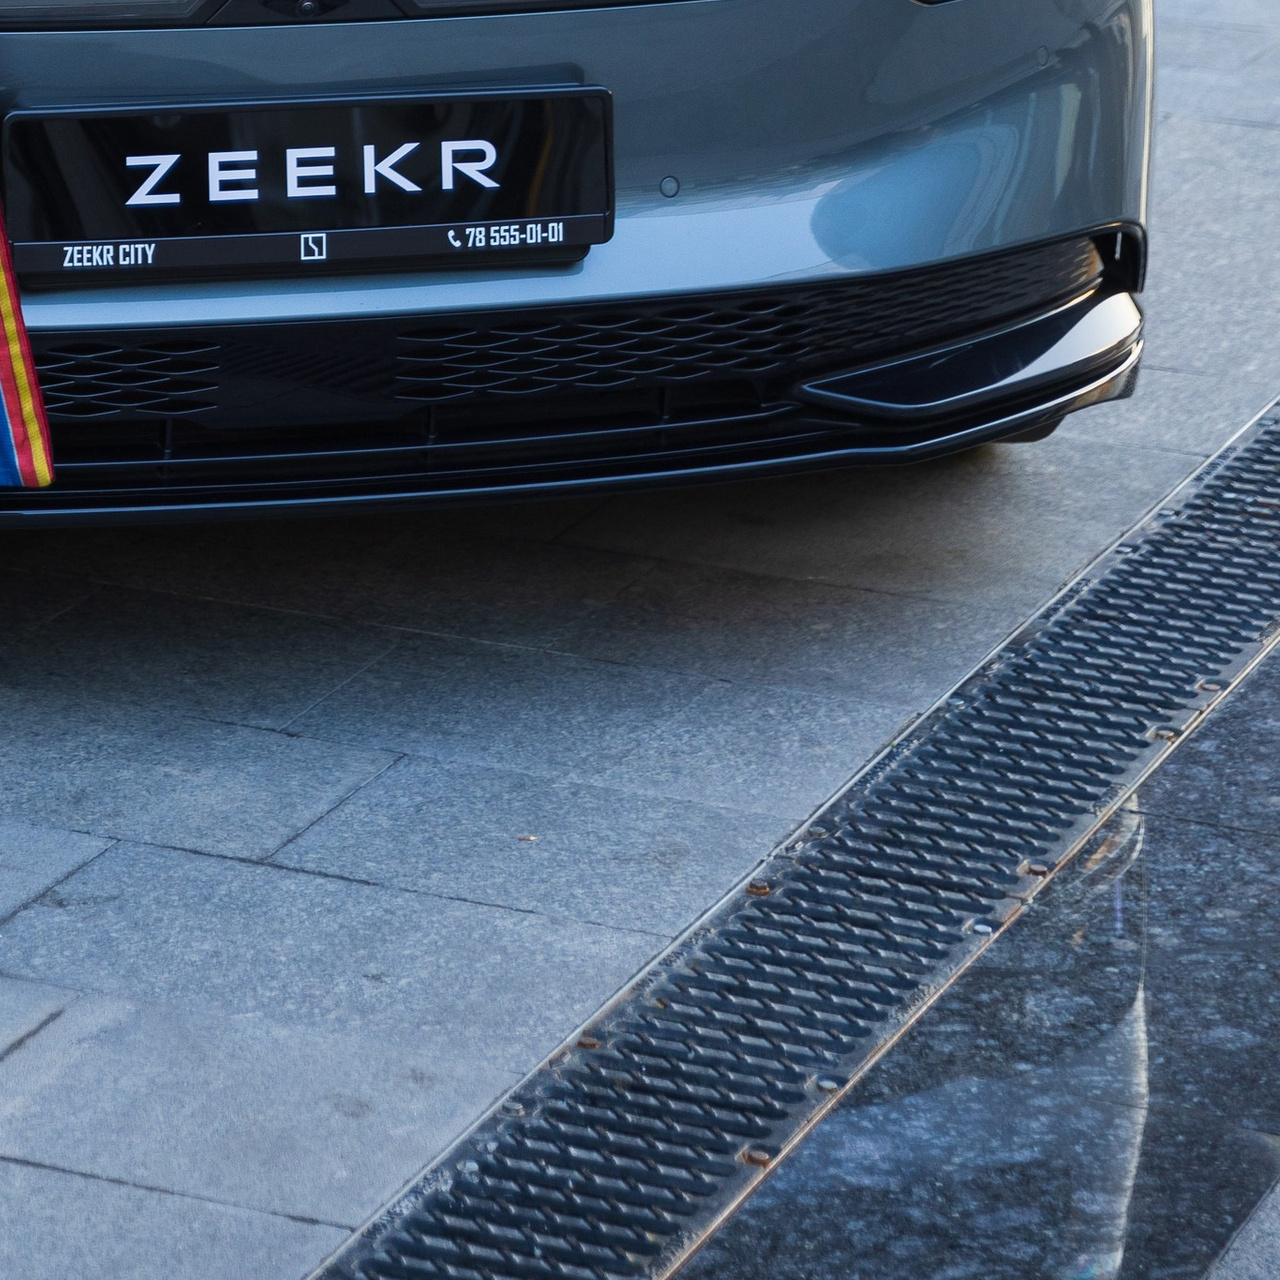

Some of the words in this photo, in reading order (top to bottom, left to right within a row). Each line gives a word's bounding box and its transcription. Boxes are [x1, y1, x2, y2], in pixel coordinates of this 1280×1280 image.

[125, 139, 501, 205] ZEEKR
[465, 226, 486, 248] 78
[489, 221, 564, 246] 555-01-01
[62, 244, 115, 267] ZEEKR
[118, 243, 156, 265] CITY
